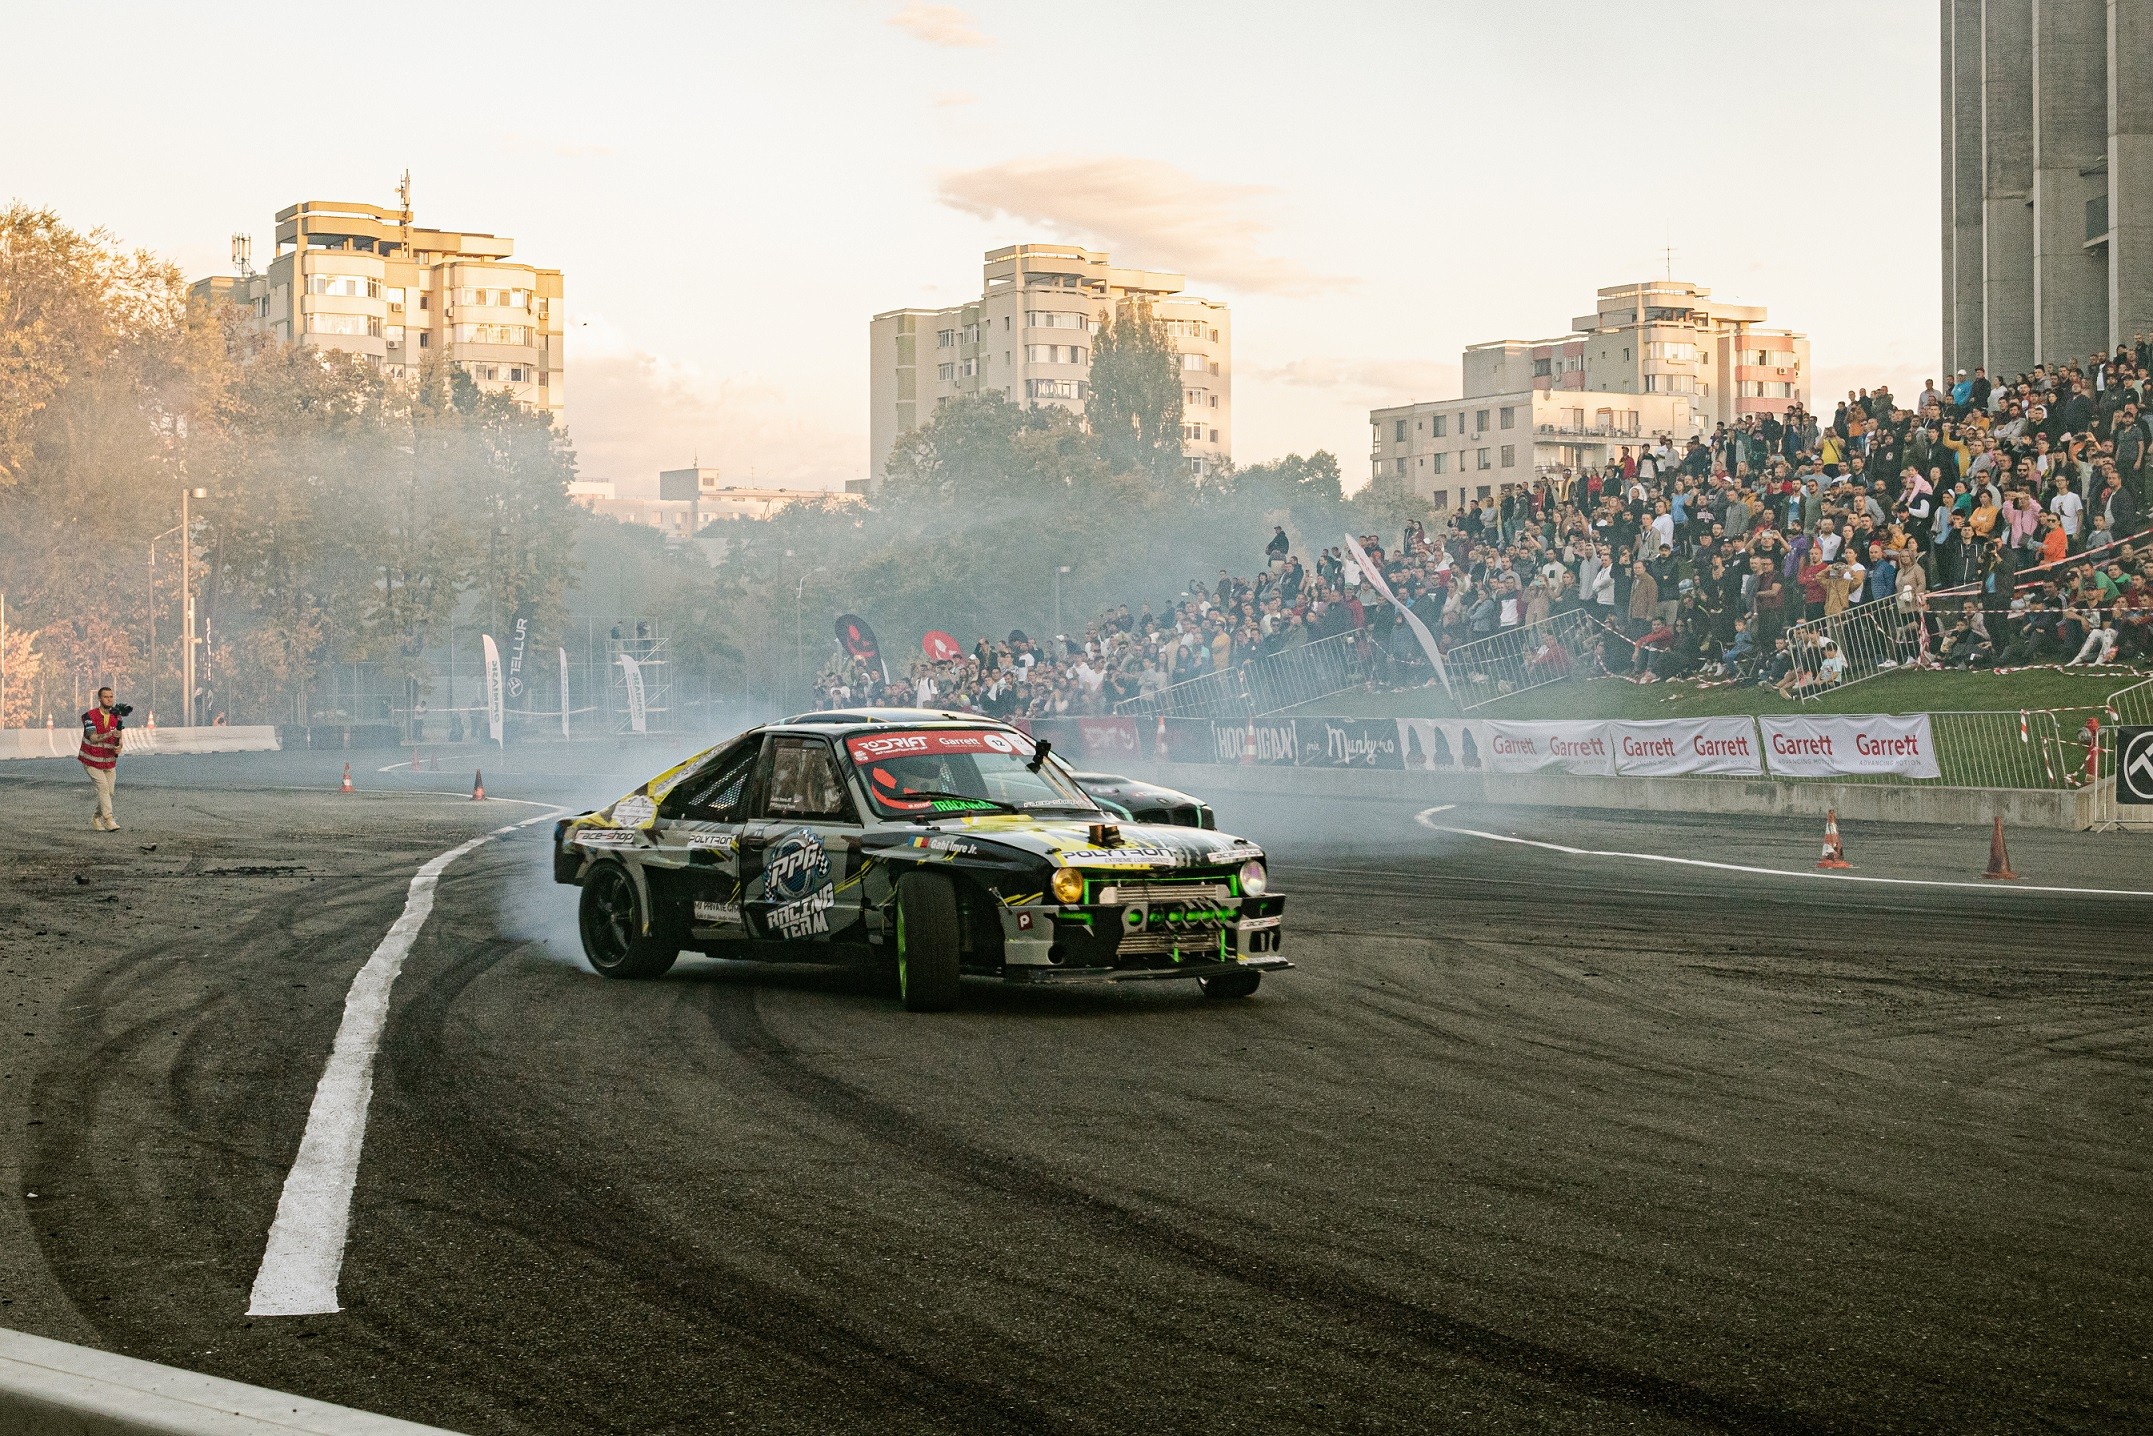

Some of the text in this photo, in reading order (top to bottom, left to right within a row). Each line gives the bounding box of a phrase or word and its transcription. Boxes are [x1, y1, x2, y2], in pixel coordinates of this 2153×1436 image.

[510, 618, 528, 676] TELLUR
[938, 737, 980, 746] Garrett
[992, 739, 1005, 747] 12
[1216, 726, 1294, 760] HOOIGAN
[1492, 734, 1537, 755] Garrett
[1549, 736, 1606, 757] Garrett
[1622, 736, 1676, 757] Garrett
[1693, 734, 1750, 757] Garrett
[1772, 733, 1833, 756] Garrett
[1855, 733, 1919, 757] Garrett
[577, 831, 635, 842] race-shop
[688, 834, 733, 845] POLYTRON
[930, 839, 979, 855] Gabi Imre Jr.
[1061, 848, 1175, 860] POLYTRON
[770, 842, 820, 888] PPG
[766, 882, 835, 929] RACING
[779, 910, 829, 940] TEAM
